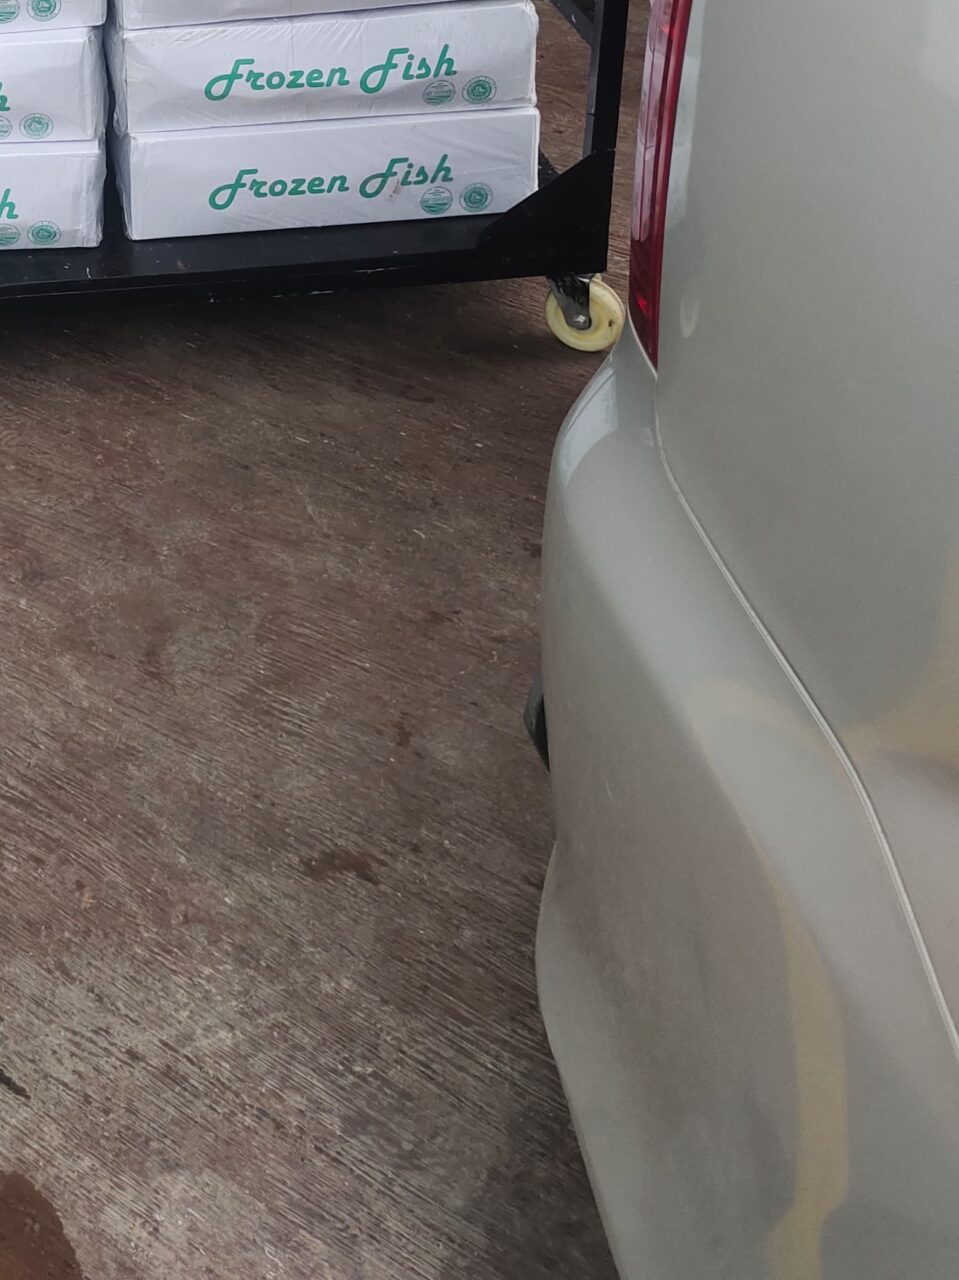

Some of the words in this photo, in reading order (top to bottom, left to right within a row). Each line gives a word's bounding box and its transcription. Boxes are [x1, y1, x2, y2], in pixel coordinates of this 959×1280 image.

[204, 58, 349, 101] Frozen
[359, 44, 456, 94] Fish
[208, 168, 347, 211] Frozen
[359, 155, 452, 199] Fish
